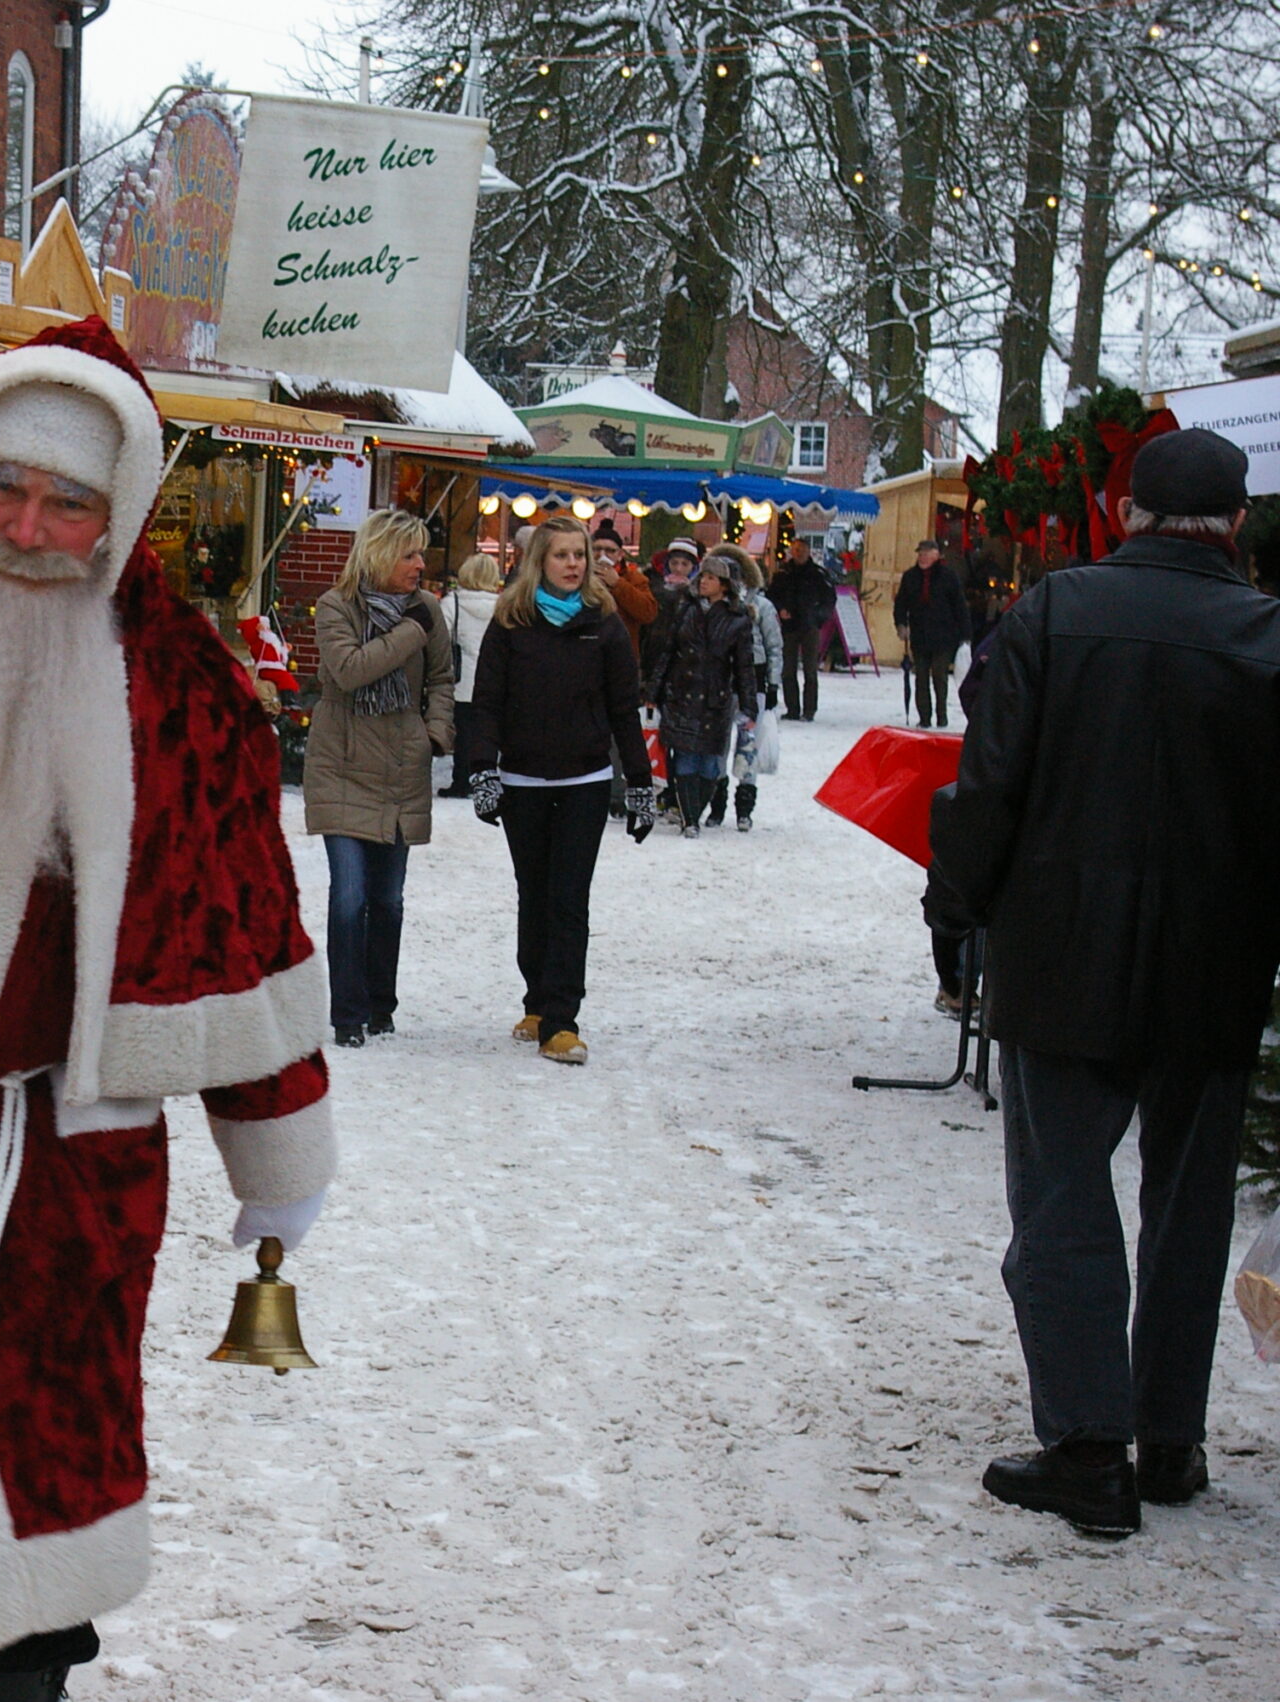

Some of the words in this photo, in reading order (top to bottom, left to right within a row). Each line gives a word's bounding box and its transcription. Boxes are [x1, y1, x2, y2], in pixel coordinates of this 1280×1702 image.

[303, 146, 370, 183] Nur
[378, 138, 438, 171] hier
[287, 200, 373, 233] heisse
[273, 243, 420, 287] Schmalz-
[262, 301, 361, 340] kuchen
[220, 424, 356, 450] Schmalzkuchen
[1192, 411, 1280, 430] FEUERZANGEN
